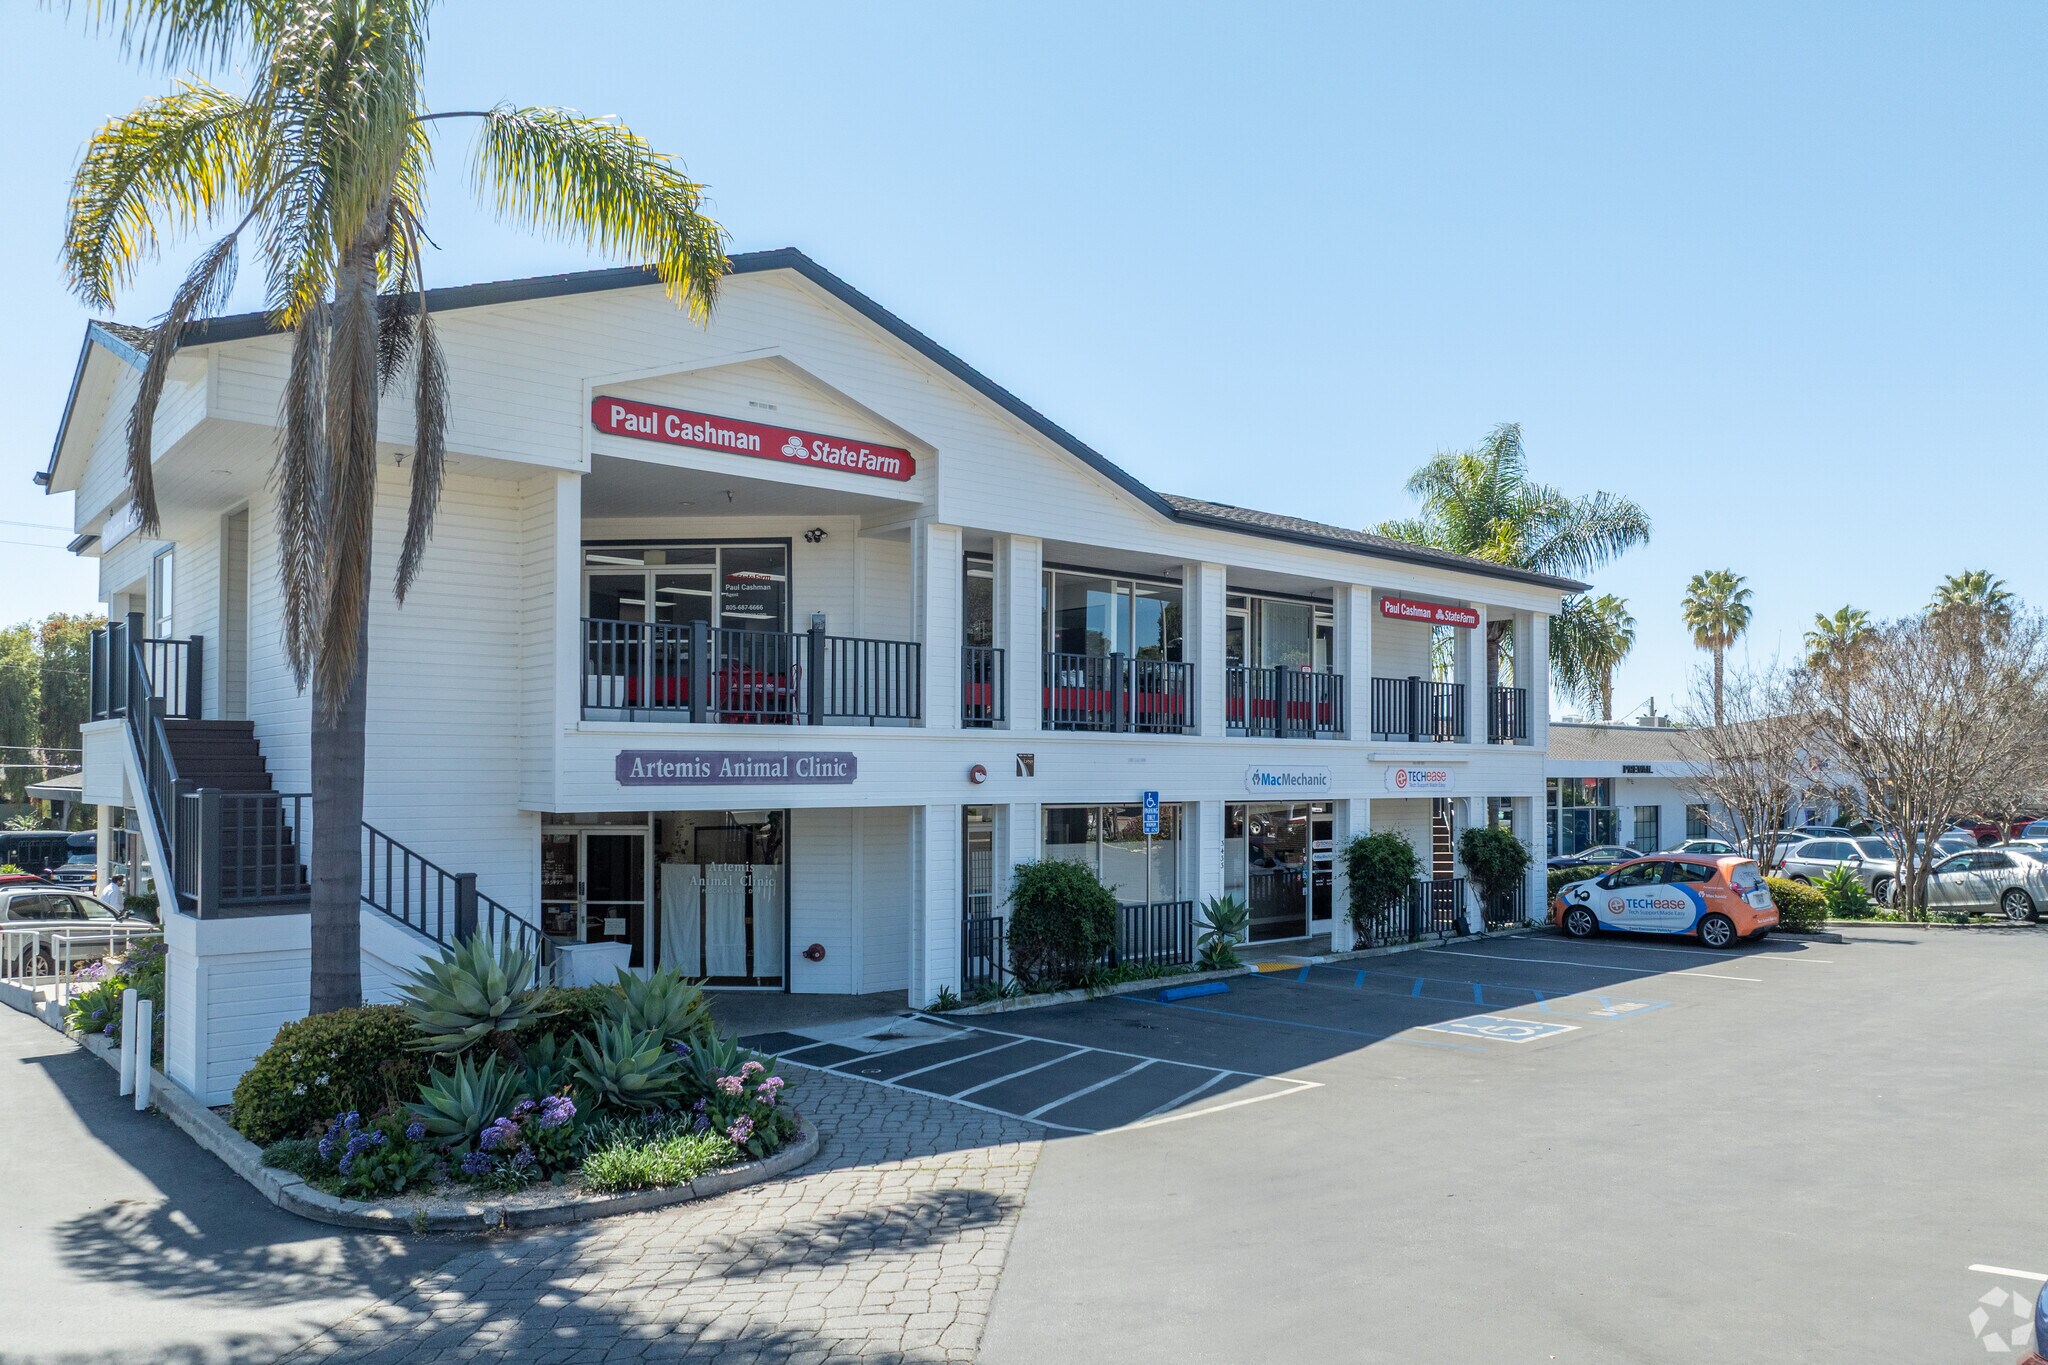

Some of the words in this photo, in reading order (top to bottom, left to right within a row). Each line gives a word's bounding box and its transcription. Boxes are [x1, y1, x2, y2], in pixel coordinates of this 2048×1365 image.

[610, 404, 658, 435] Paul
[664, 414, 761, 452] Cashman
[725, 583, 740, 591] Paul
[741, 583, 772, 591] Cashman
[1385, 601, 1399, 614] Paul
[1401, 604, 1431, 618] Cashman
[629, 756, 711, 778] Artemis
[718, 756, 789, 778] Animal
[795, 755, 847, 777] Clinic
[1261, 772, 1327, 786] MacMechanic
[1408, 771, 1447, 782] TECHease
[709, 861, 755, 872] Artemis
[689, 875, 732, 886] Animal
[740, 874, 776, 887] Clinic
[1626, 899, 1686, 910] TECHease
